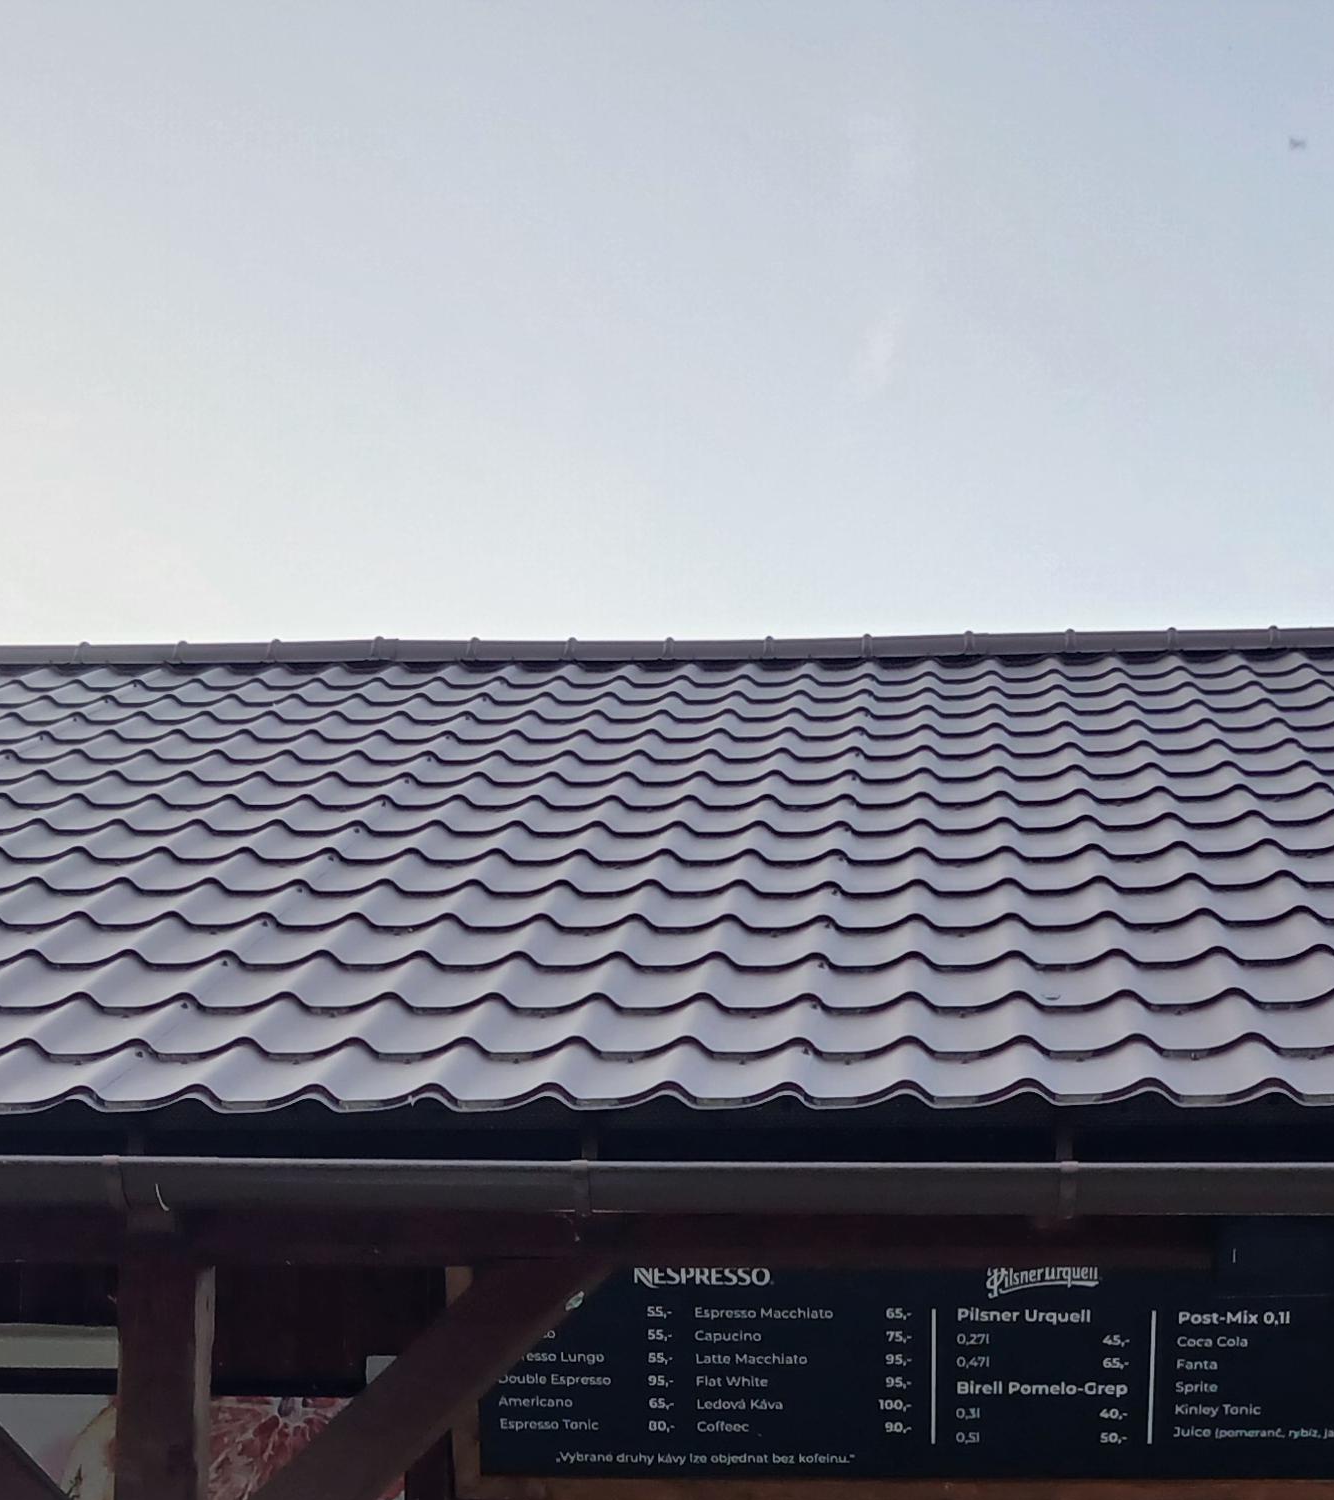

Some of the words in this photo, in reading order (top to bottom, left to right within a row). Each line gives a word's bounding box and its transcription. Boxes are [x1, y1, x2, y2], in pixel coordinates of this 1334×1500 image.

[633, 1267, 773, 1289] NESPRESSO
[646, 1305, 673, 1319] 55,-
[694, 1306, 757, 1321] Espresso
[760, 1306, 834, 1320] Macchiato
[885, 1307, 912, 1321] 65,-
[957, 1306, 1020, 1322] Pilsner
[1024, 1308, 1091, 1326] Urquell
[1178, 1309, 1259, 1325] Post-Mix
[647, 1328, 673, 1342] 55,-
[694, 1329, 762, 1344] Capucino
[885, 1330, 912, 1344] 75,-
[1102, 1334, 1131, 1348] 45,-
[1176, 1336, 1213, 1348] Coca
[1216, 1336, 1249, 1348] Cola
[521, 1352, 557, 1362] esso
[560, 1351, 605, 1366] Lungo
[695, 1353, 731, 1365] Latte
[735, 1352, 808, 1365] Macchiato
[885, 1353, 912, 1367] 95,-
[1102, 1357, 1130, 1370] 65,-
[1176, 1358, 1218, 1371] Fanta
[498, 1372, 547, 1385] Double
[550, 1373, 612, 1387] Espresso
[647, 1374, 674, 1388] 95,-
[695, 1375, 722, 1387] Flat
[725, 1375, 769, 1388] White
[885, 1376, 912, 1390] 95,-
[956, 1380, 1003, 1395] Birell
[1008, 1381, 1128, 1398] Pomelo-Grep
[1175, 1380, 1219, 1396] Sprite
[498, 1395, 573, 1408] Americano
[696, 1398, 746, 1410] Ledová
[750, 1398, 784, 1410] Káva
[878, 1398, 912, 1412] 100,-
[1099, 1408, 1128, 1421] 40,-
[1174, 1403, 1220, 1418] Kinley
[1222, 1403, 1261, 1416] Tonic
[499, 1417, 559, 1432] Espresso
[562, 1418, 599, 1431] Tonic
[884, 1421, 912, 1434] 90,-
[1173, 1425, 1212, 1438] Juice
[1100, 1432, 1128, 1445] 50,-
[616, 1452, 655, 1466] druhy
[657, 1452, 687, 1466] kávy
[689, 1452, 708, 1464] lze
[710, 1452, 769, 1466] objednat
[772, 1452, 795, 1464] bez
